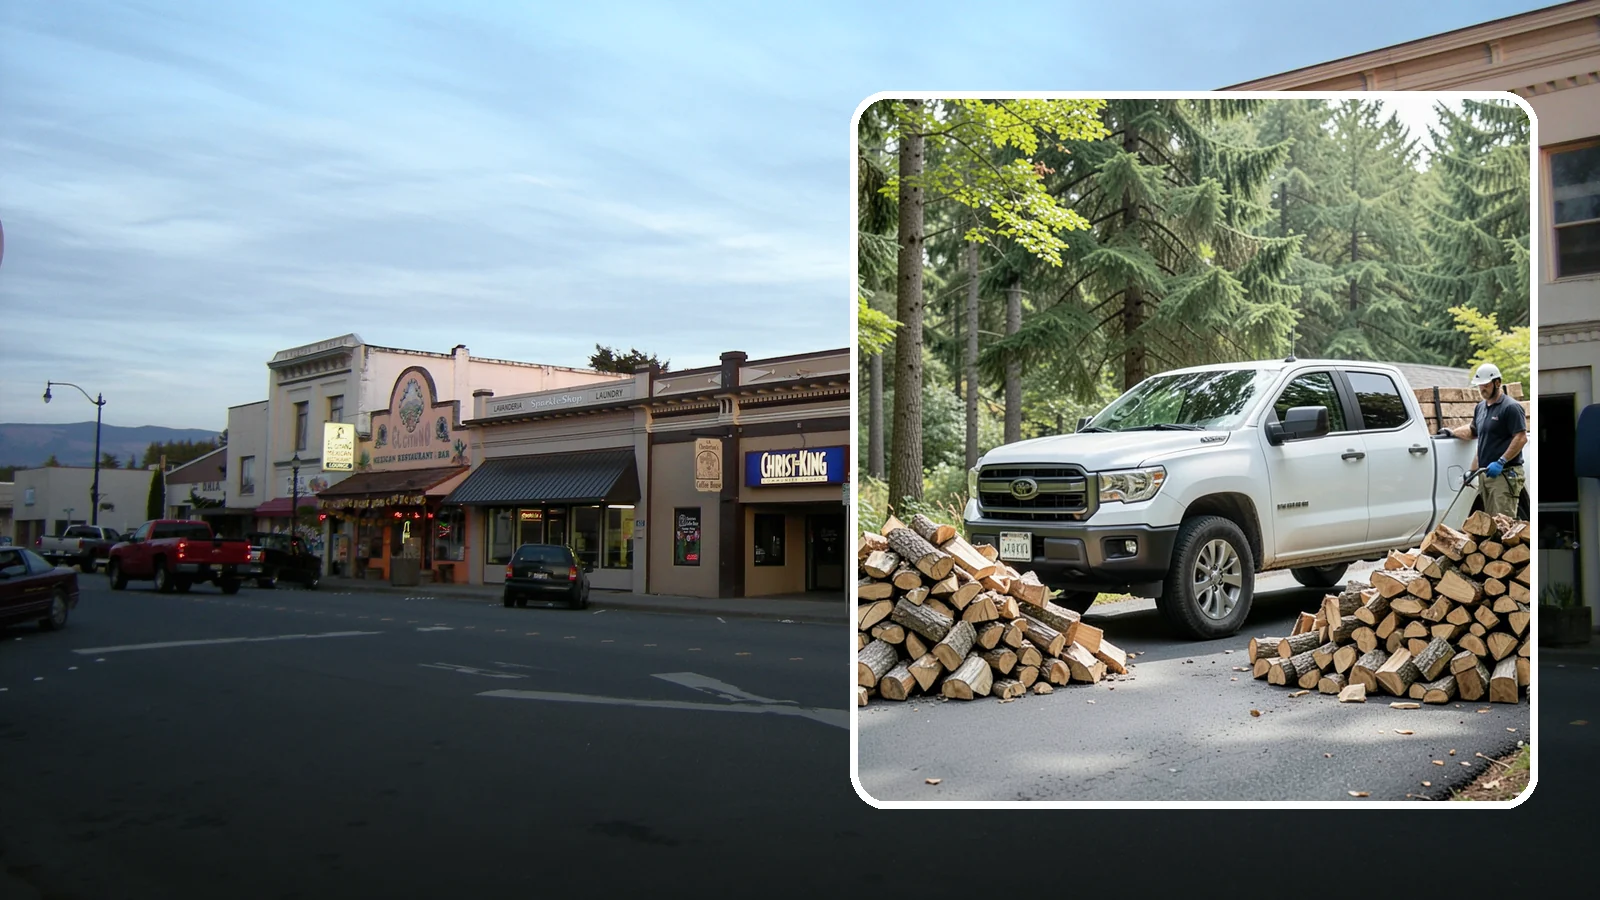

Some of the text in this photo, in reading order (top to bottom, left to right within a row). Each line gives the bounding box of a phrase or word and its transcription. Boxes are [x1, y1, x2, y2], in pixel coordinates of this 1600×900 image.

[595, 389, 623, 400] LAUNDRY
[493, 402, 522, 412] LAVANDERIA
[531, 395, 583, 408] Sparkle Shop
[373, 450, 450, 464] MEXICAN RESTAURANT BAR
[761, 450, 827, 478] CHRIST KING
[696, 480, 722, 488] Coffee House
